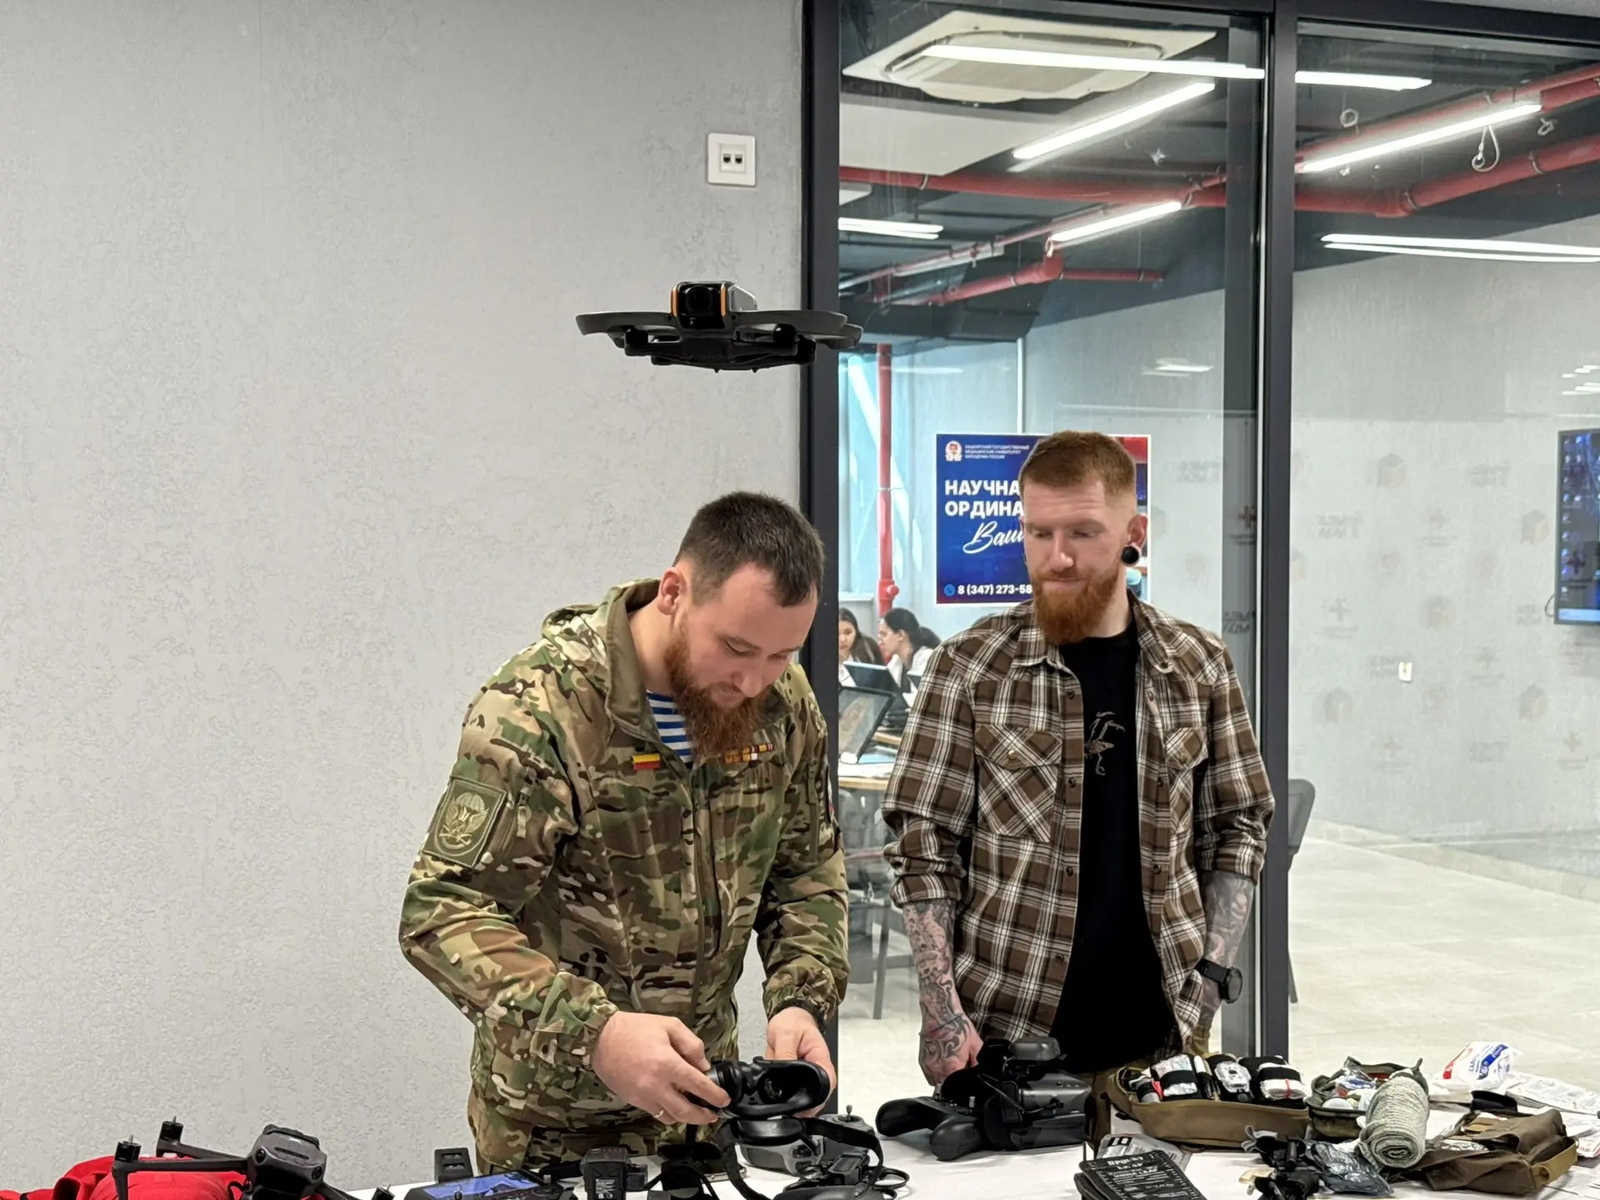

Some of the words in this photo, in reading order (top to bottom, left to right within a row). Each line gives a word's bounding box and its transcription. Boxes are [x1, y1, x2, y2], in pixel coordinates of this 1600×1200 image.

[944, 479, 1020, 496] НАУЧНА
[944, 500, 1025, 519] ОРДИНА
[957, 584, 965, 595] 8
[966, 583, 994, 595] (347)
[995, 584, 1033, 594] 273-58
